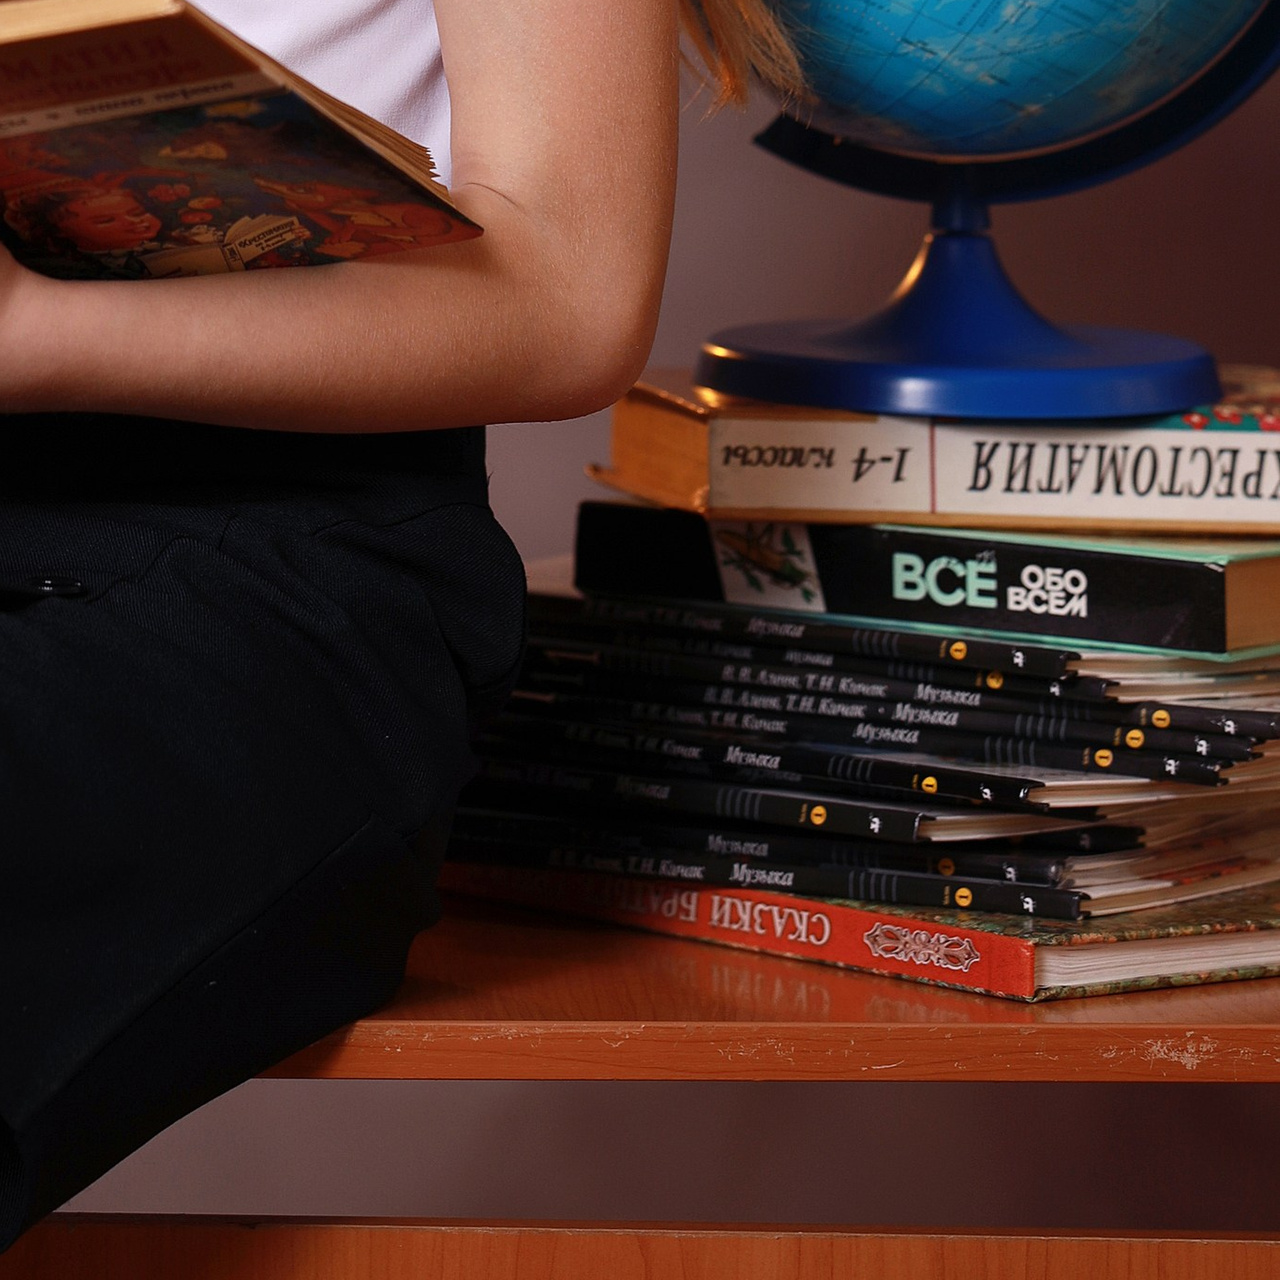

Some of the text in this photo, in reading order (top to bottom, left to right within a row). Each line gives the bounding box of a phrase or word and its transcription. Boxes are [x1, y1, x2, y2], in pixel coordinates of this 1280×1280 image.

[722, 444, 911, 484] 1-4 классы
[892, 551, 998, 609] ВСЕ
[1021, 564, 1088, 594] ОБО
[1007, 586, 1088, 618] ВСЕМ
[914, 683, 981, 707] Музыка
[891, 702, 959, 726] Музыка
[852, 722, 920, 744] Музыка
[723, 745, 781, 770] Музыка
[728, 862, 795, 887] Музыка
[709, 895, 831, 946] СКАЗКИ
